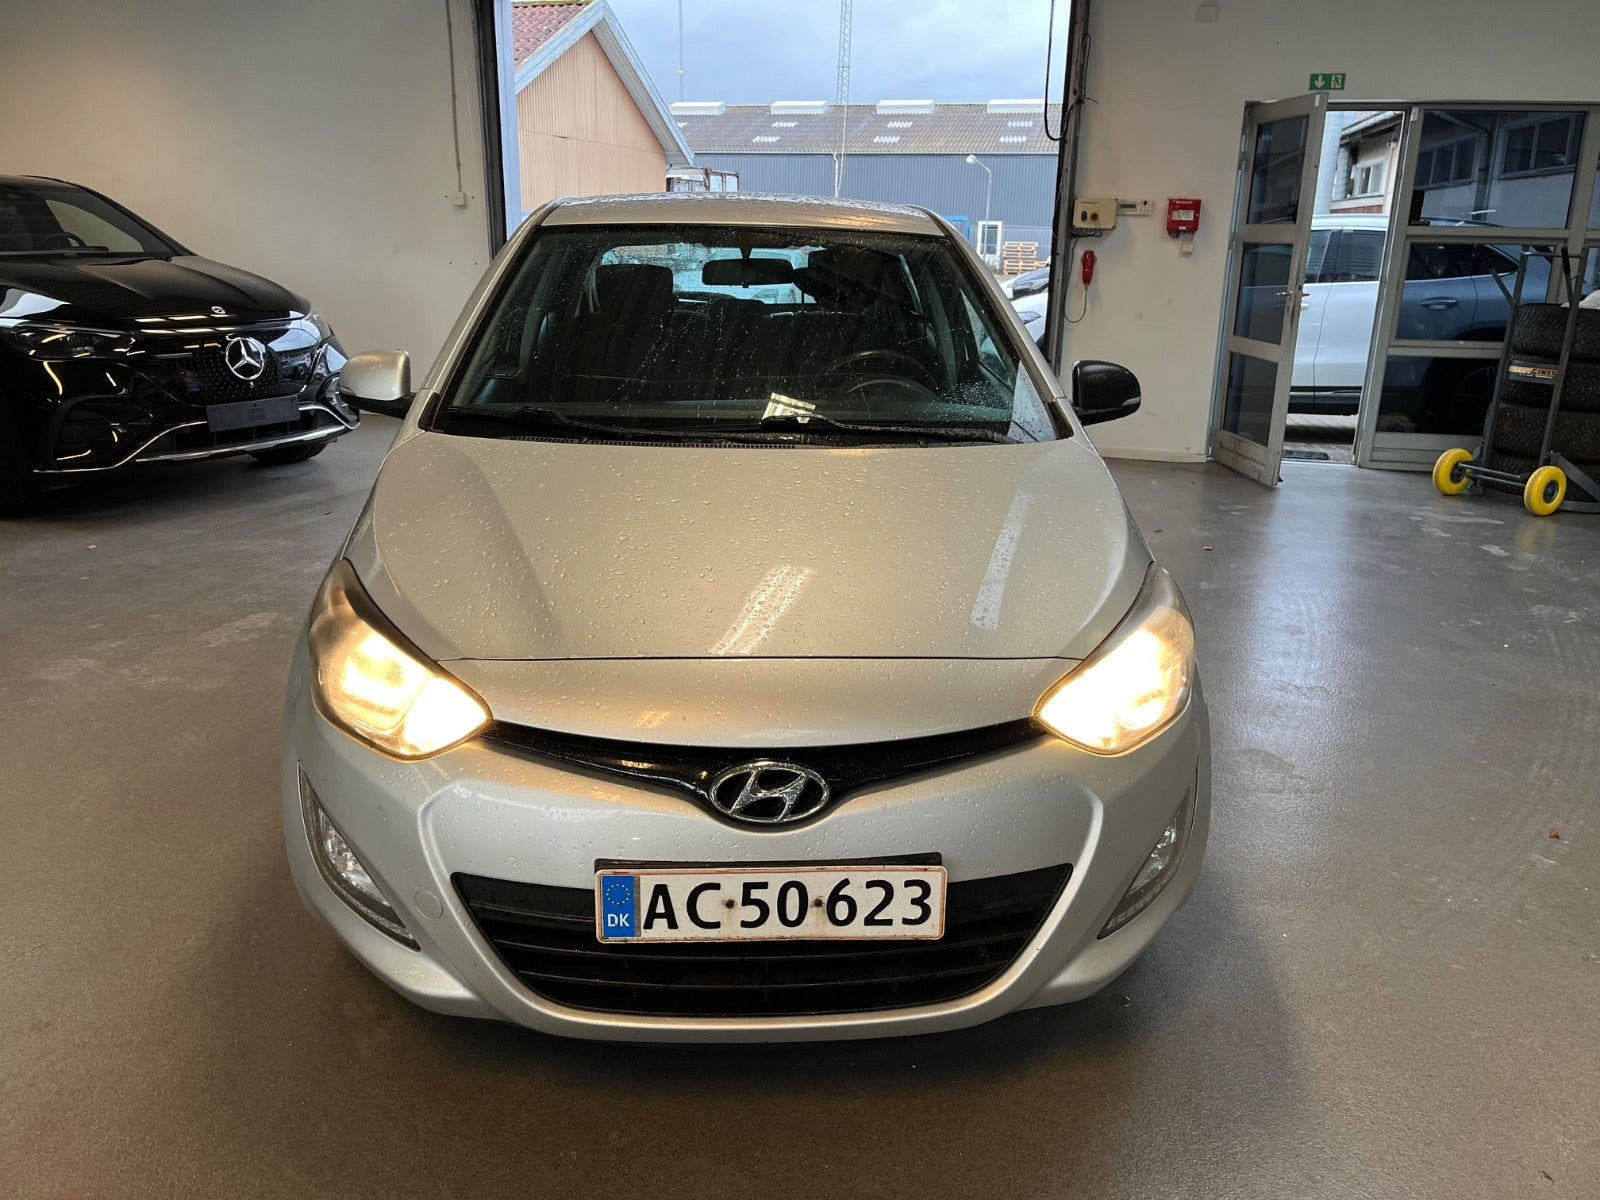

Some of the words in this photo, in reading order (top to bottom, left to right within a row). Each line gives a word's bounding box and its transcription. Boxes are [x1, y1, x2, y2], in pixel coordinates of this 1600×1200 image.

[607, 913, 630, 927] DK
[643, 882, 721, 930] AC
[740, 880, 809, 929] 50
[826, 877, 932, 927] 623
